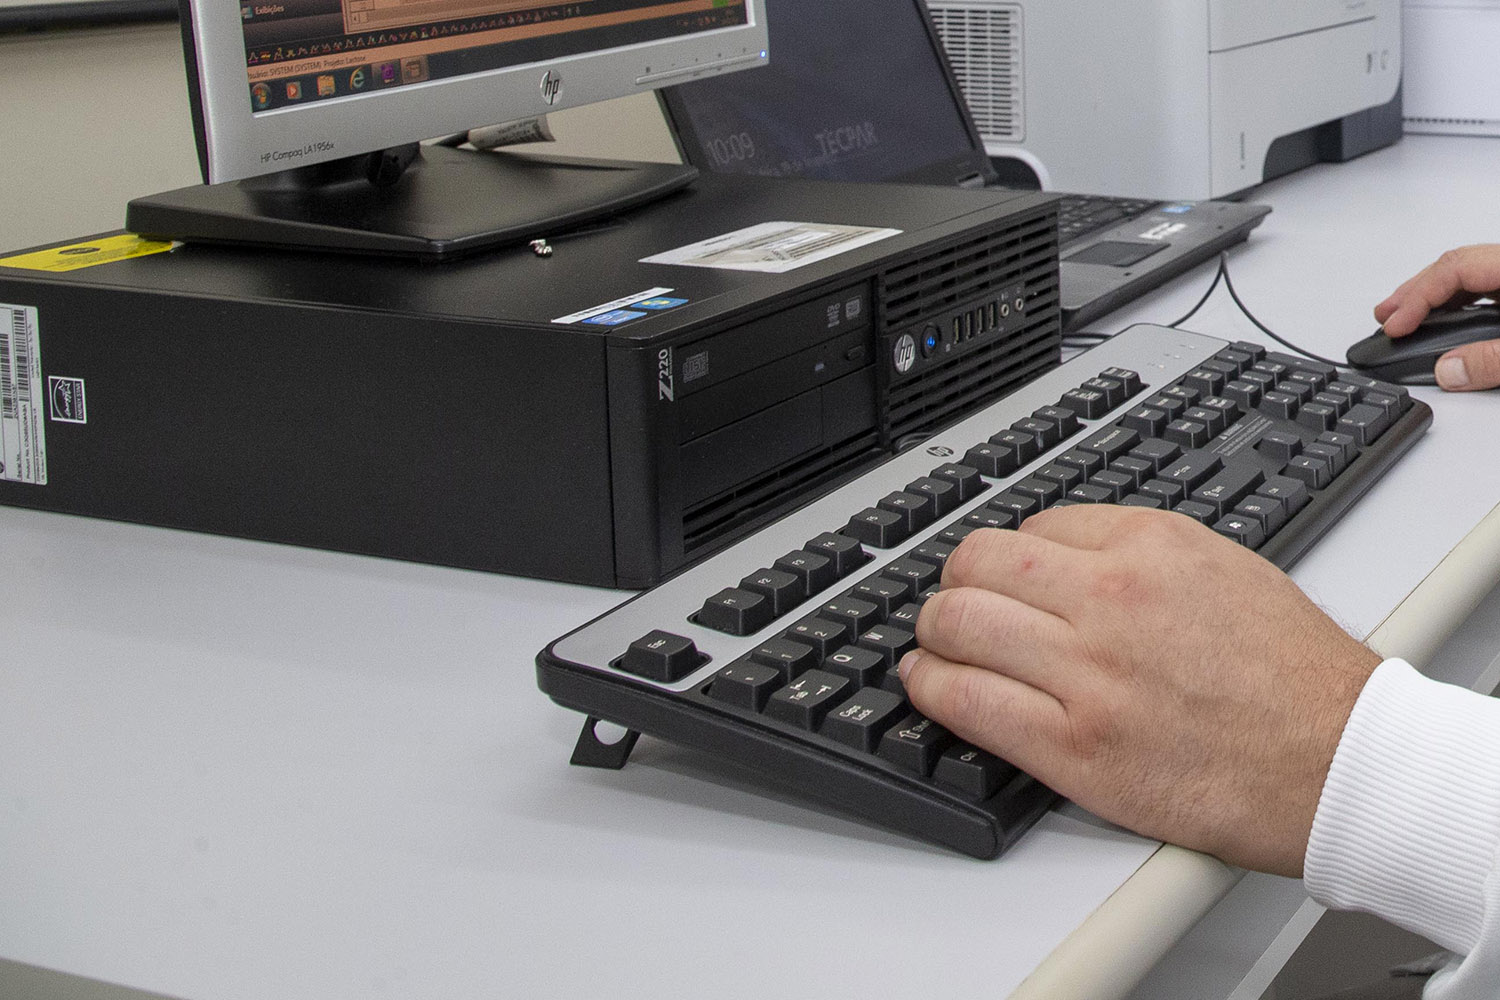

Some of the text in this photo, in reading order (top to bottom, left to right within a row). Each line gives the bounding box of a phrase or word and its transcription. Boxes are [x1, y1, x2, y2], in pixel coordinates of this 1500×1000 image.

[269, 64, 293, 77] SYSTEM
[542, 70, 561, 105] hp
[260, 141, 335, 164] HP Compaq LA1956x
[896, 334, 914, 372] hp
[658, 348, 674, 402] Z220
[832, 654, 854, 663] Q
